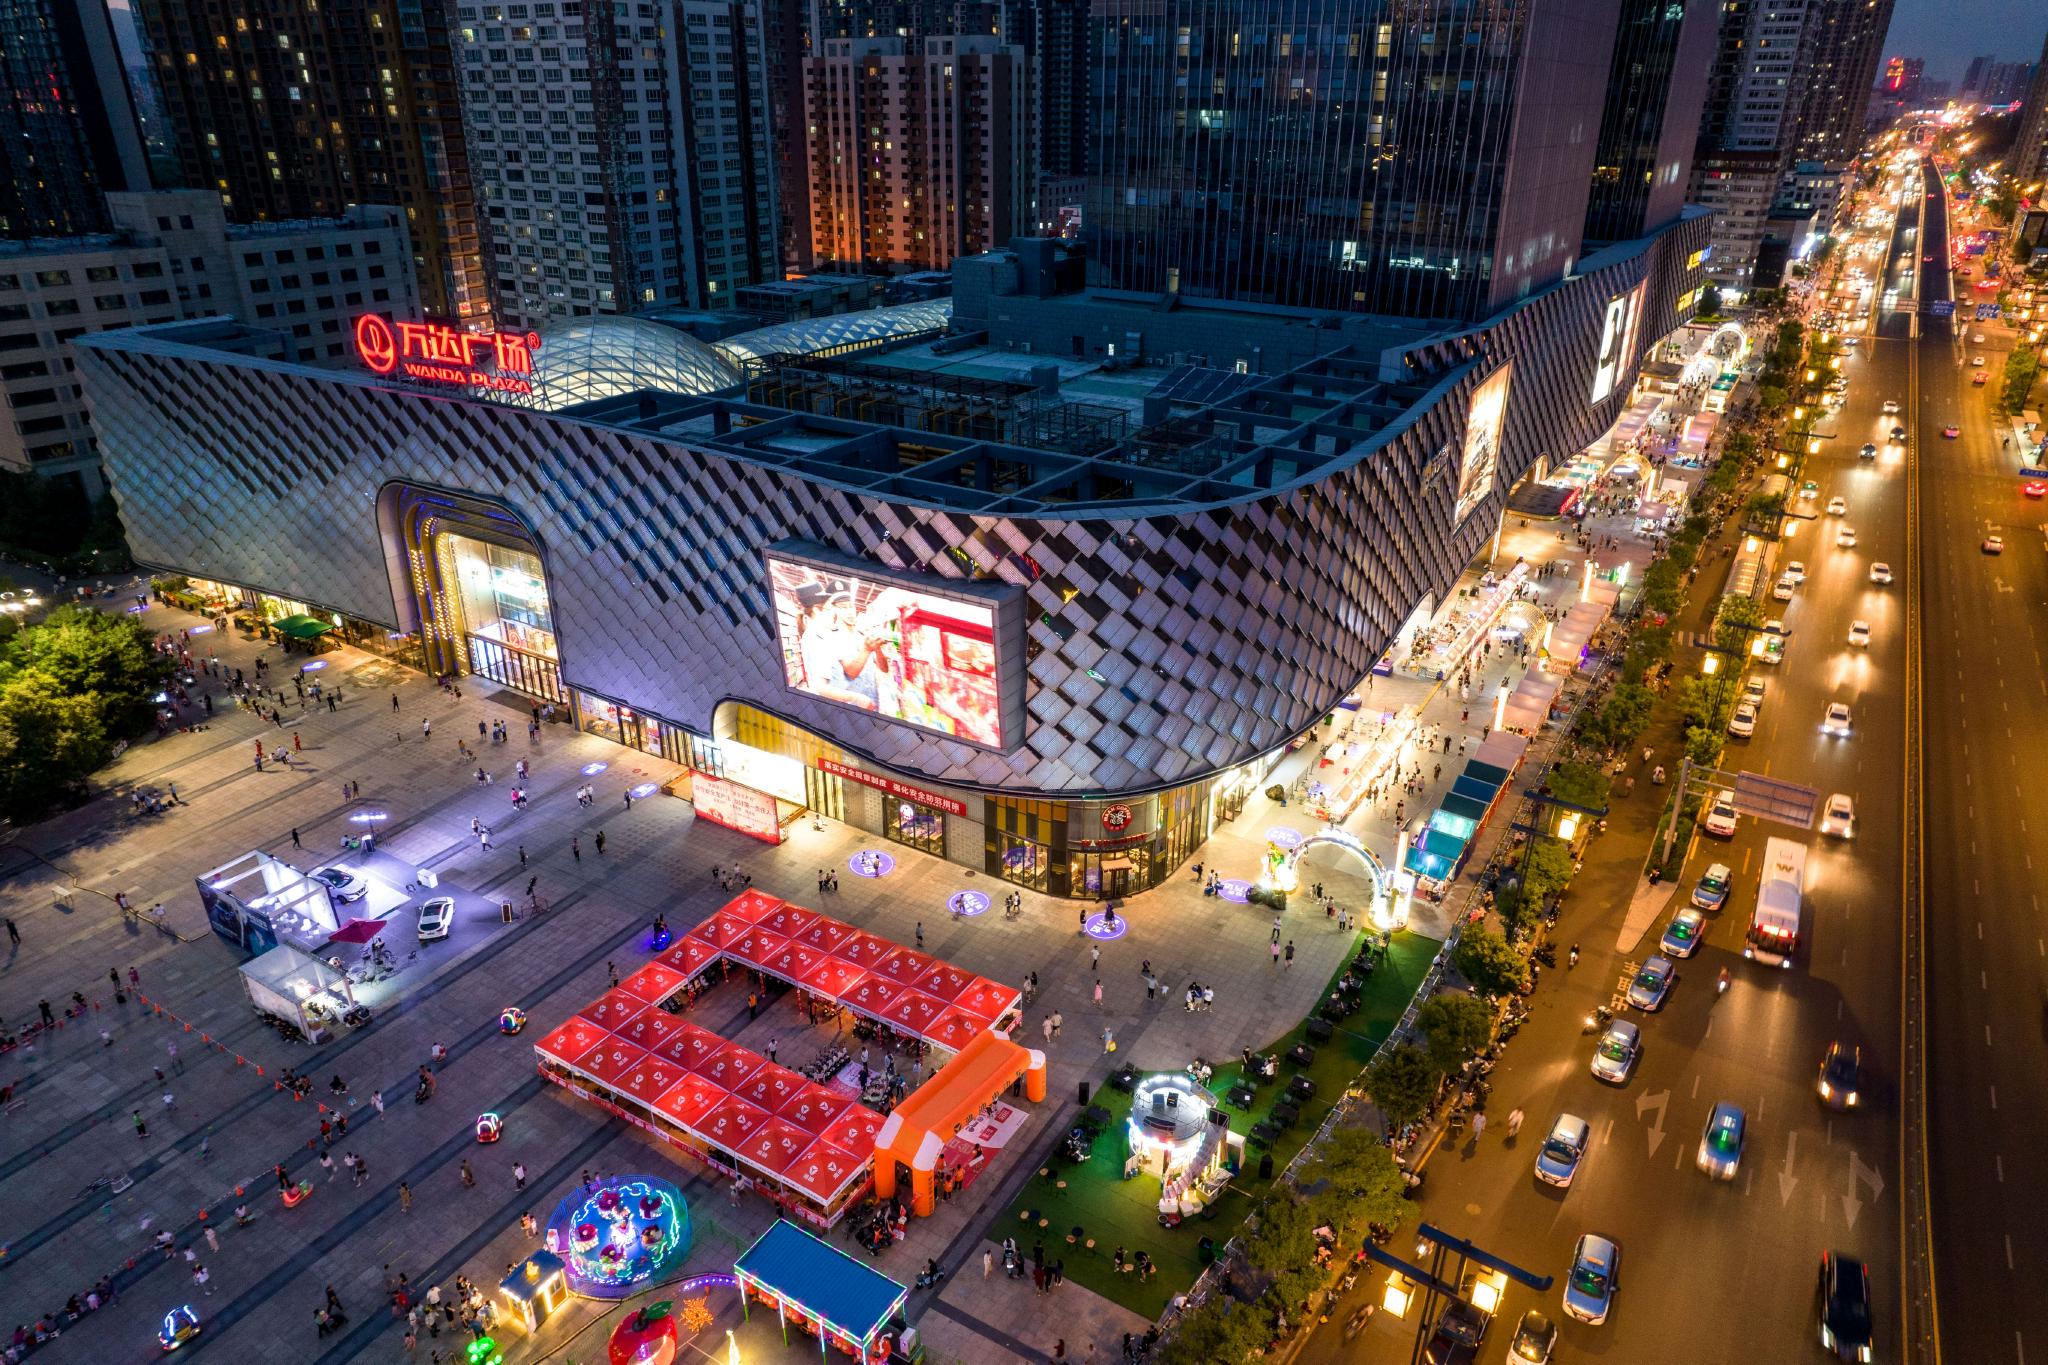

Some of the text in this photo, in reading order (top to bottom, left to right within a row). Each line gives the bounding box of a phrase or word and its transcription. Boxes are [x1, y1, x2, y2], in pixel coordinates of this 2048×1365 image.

[396, 322, 531, 374] 万达广场
[404, 364, 532, 393] WANDA PLAZA
